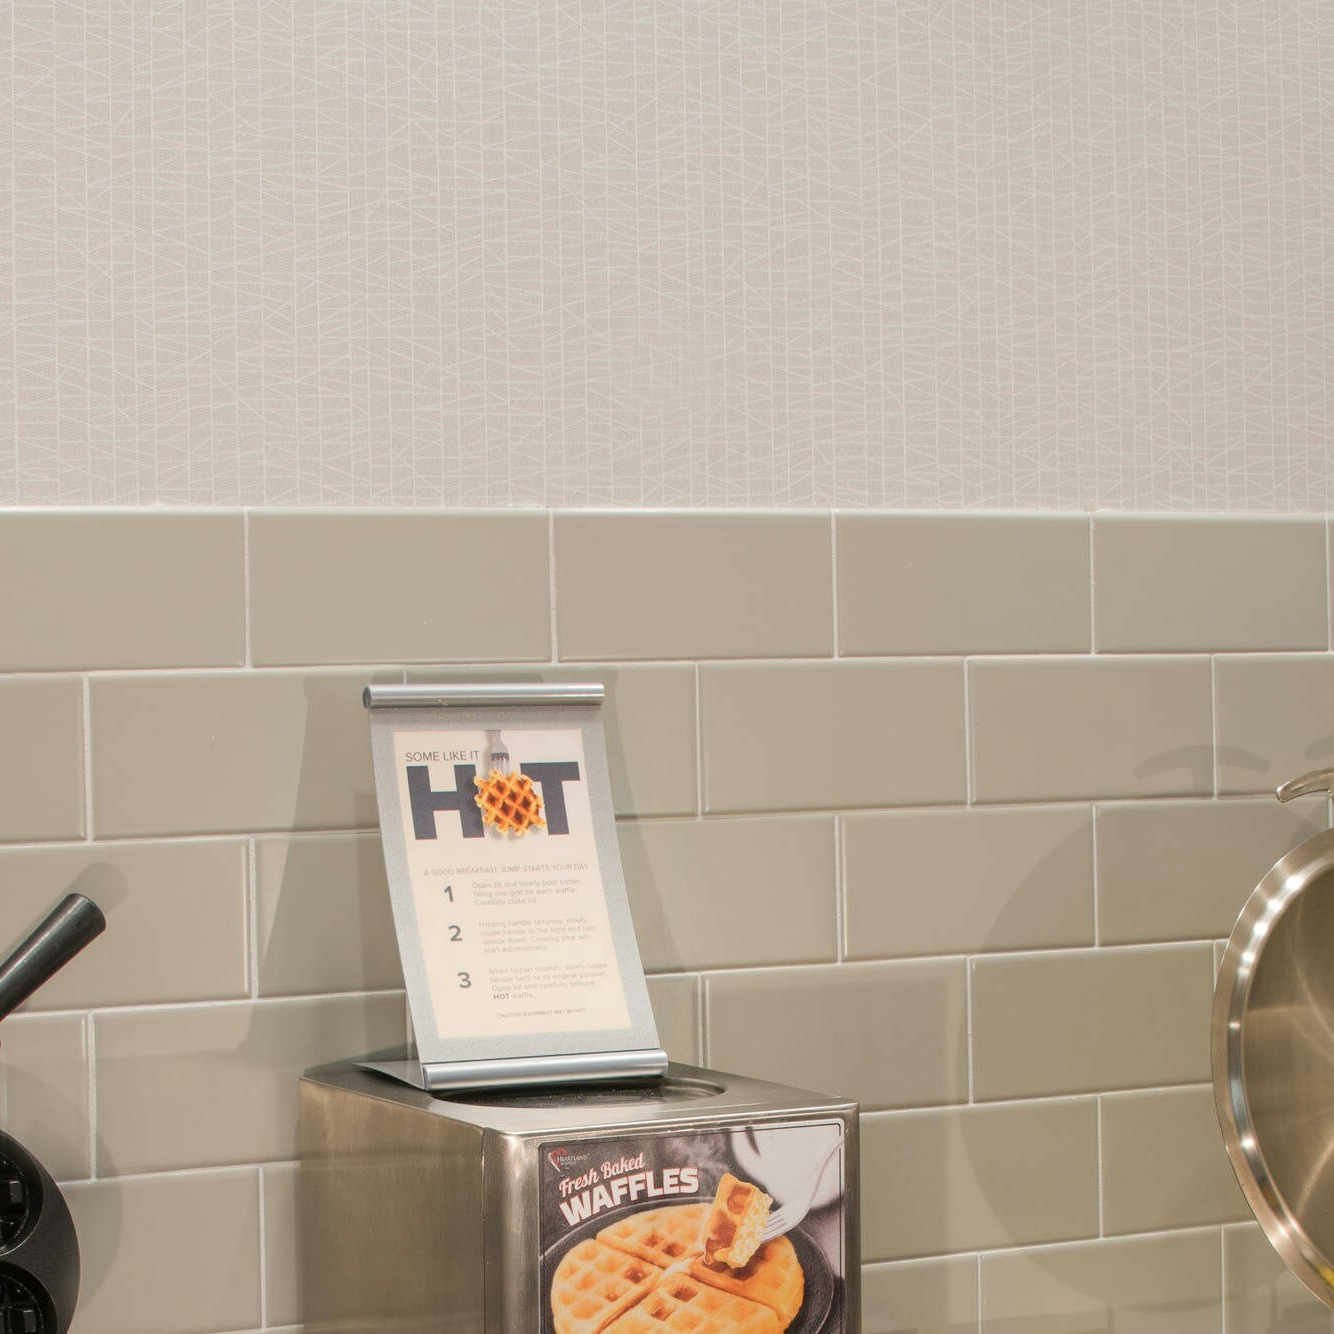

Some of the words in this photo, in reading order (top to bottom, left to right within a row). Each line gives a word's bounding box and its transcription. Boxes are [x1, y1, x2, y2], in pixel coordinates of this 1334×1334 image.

[405, 751, 440, 762] SOME
[443, 750, 467, 761] LIKE
[470, 750, 480, 760] IT
[444, 885, 454, 903] 1
[447, 924, 464, 942] 2
[457, 971, 472, 989] 3
[558, 1168, 600, 1198] Fresh
[601, 1151, 646, 1179] Baked
[559, 1167, 699, 1227] WAFFLES
